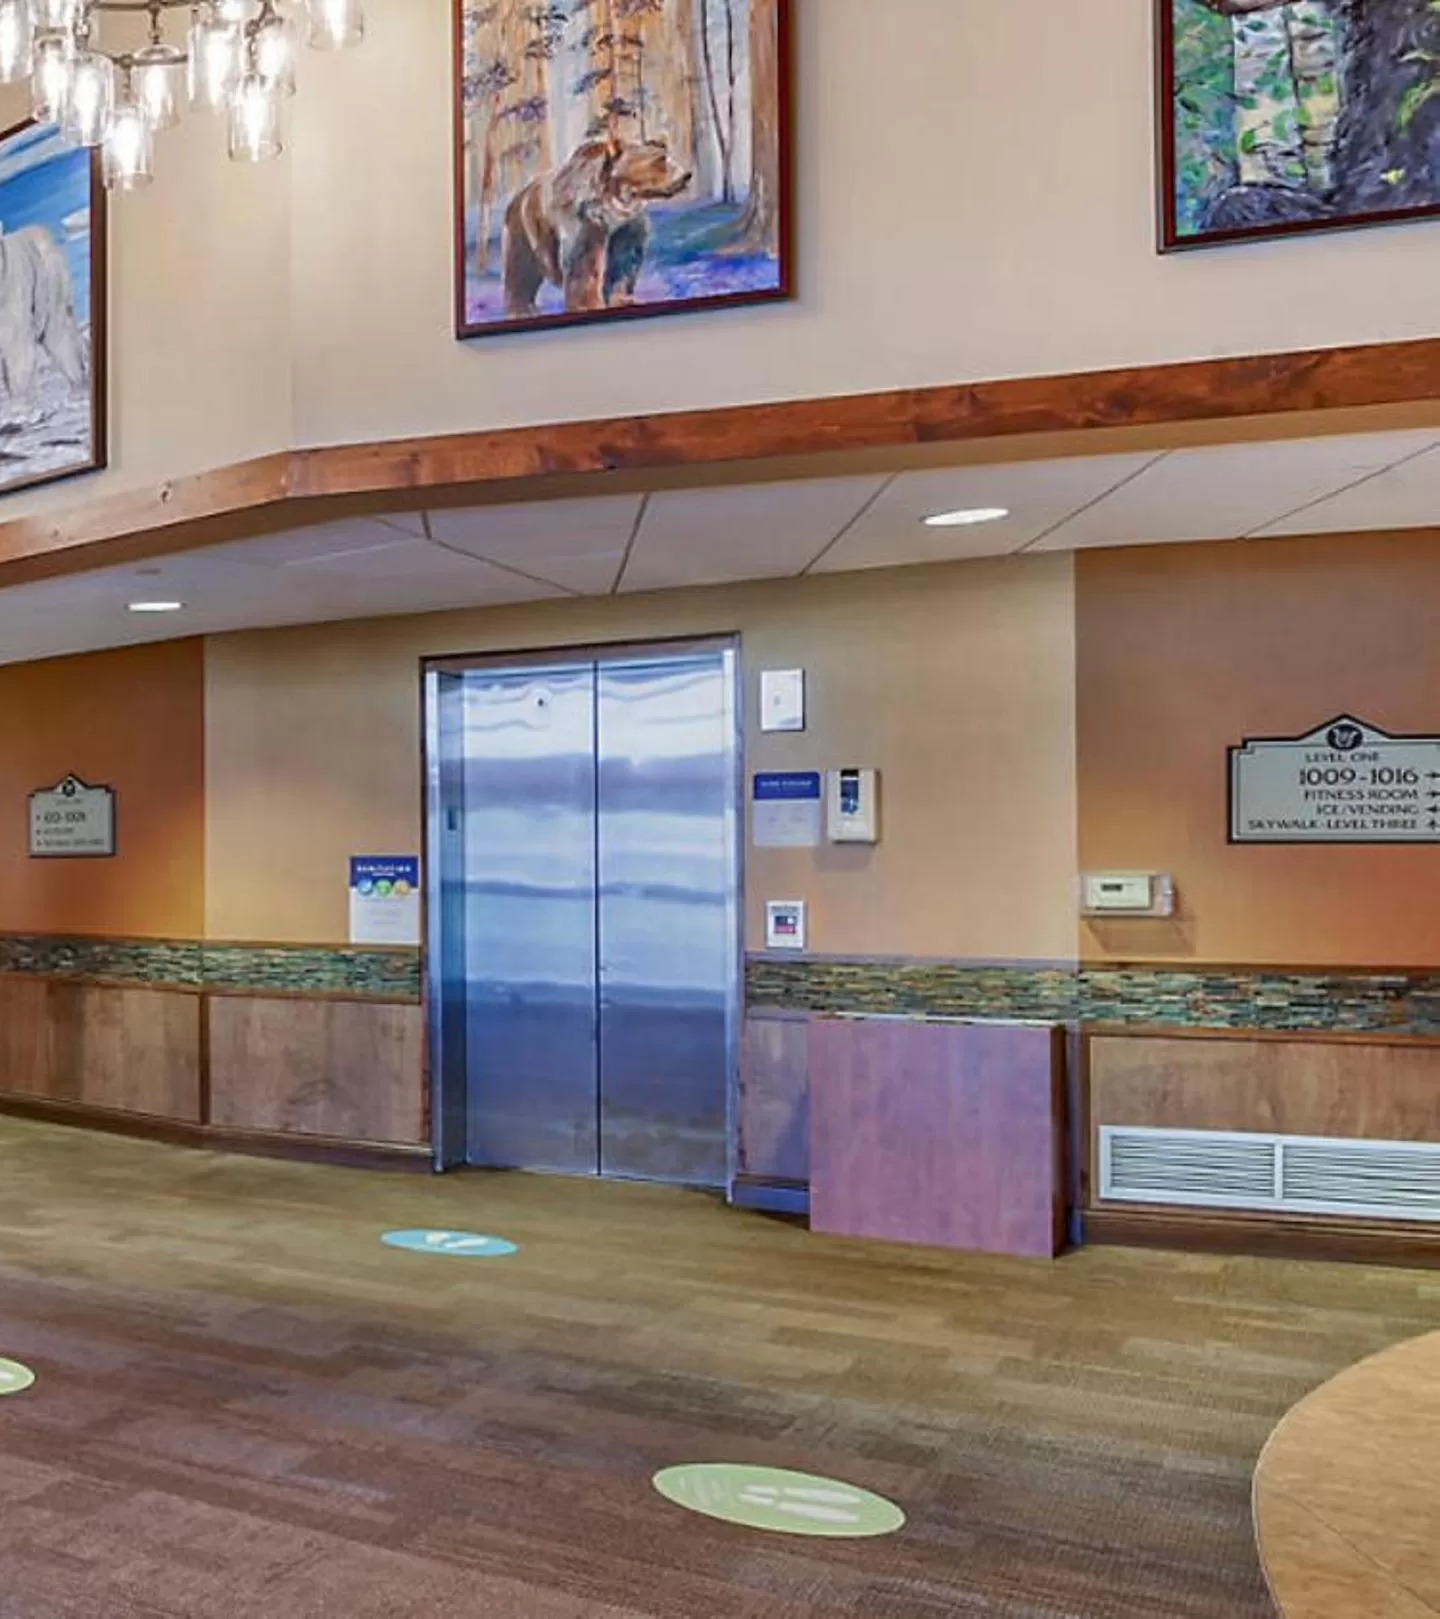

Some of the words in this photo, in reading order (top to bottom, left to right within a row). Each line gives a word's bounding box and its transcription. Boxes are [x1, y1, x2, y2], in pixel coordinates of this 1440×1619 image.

[1305, 752, 1345, 762] LEVEL
[1350, 751, 1379, 762] ONE
[1304, 789, 1366, 800] FITNESS
[1369, 789, 1418, 800] ROOM
[1316, 804, 1419, 815] ICE/VENDING
[1372, 819, 1417, 829] THREE
